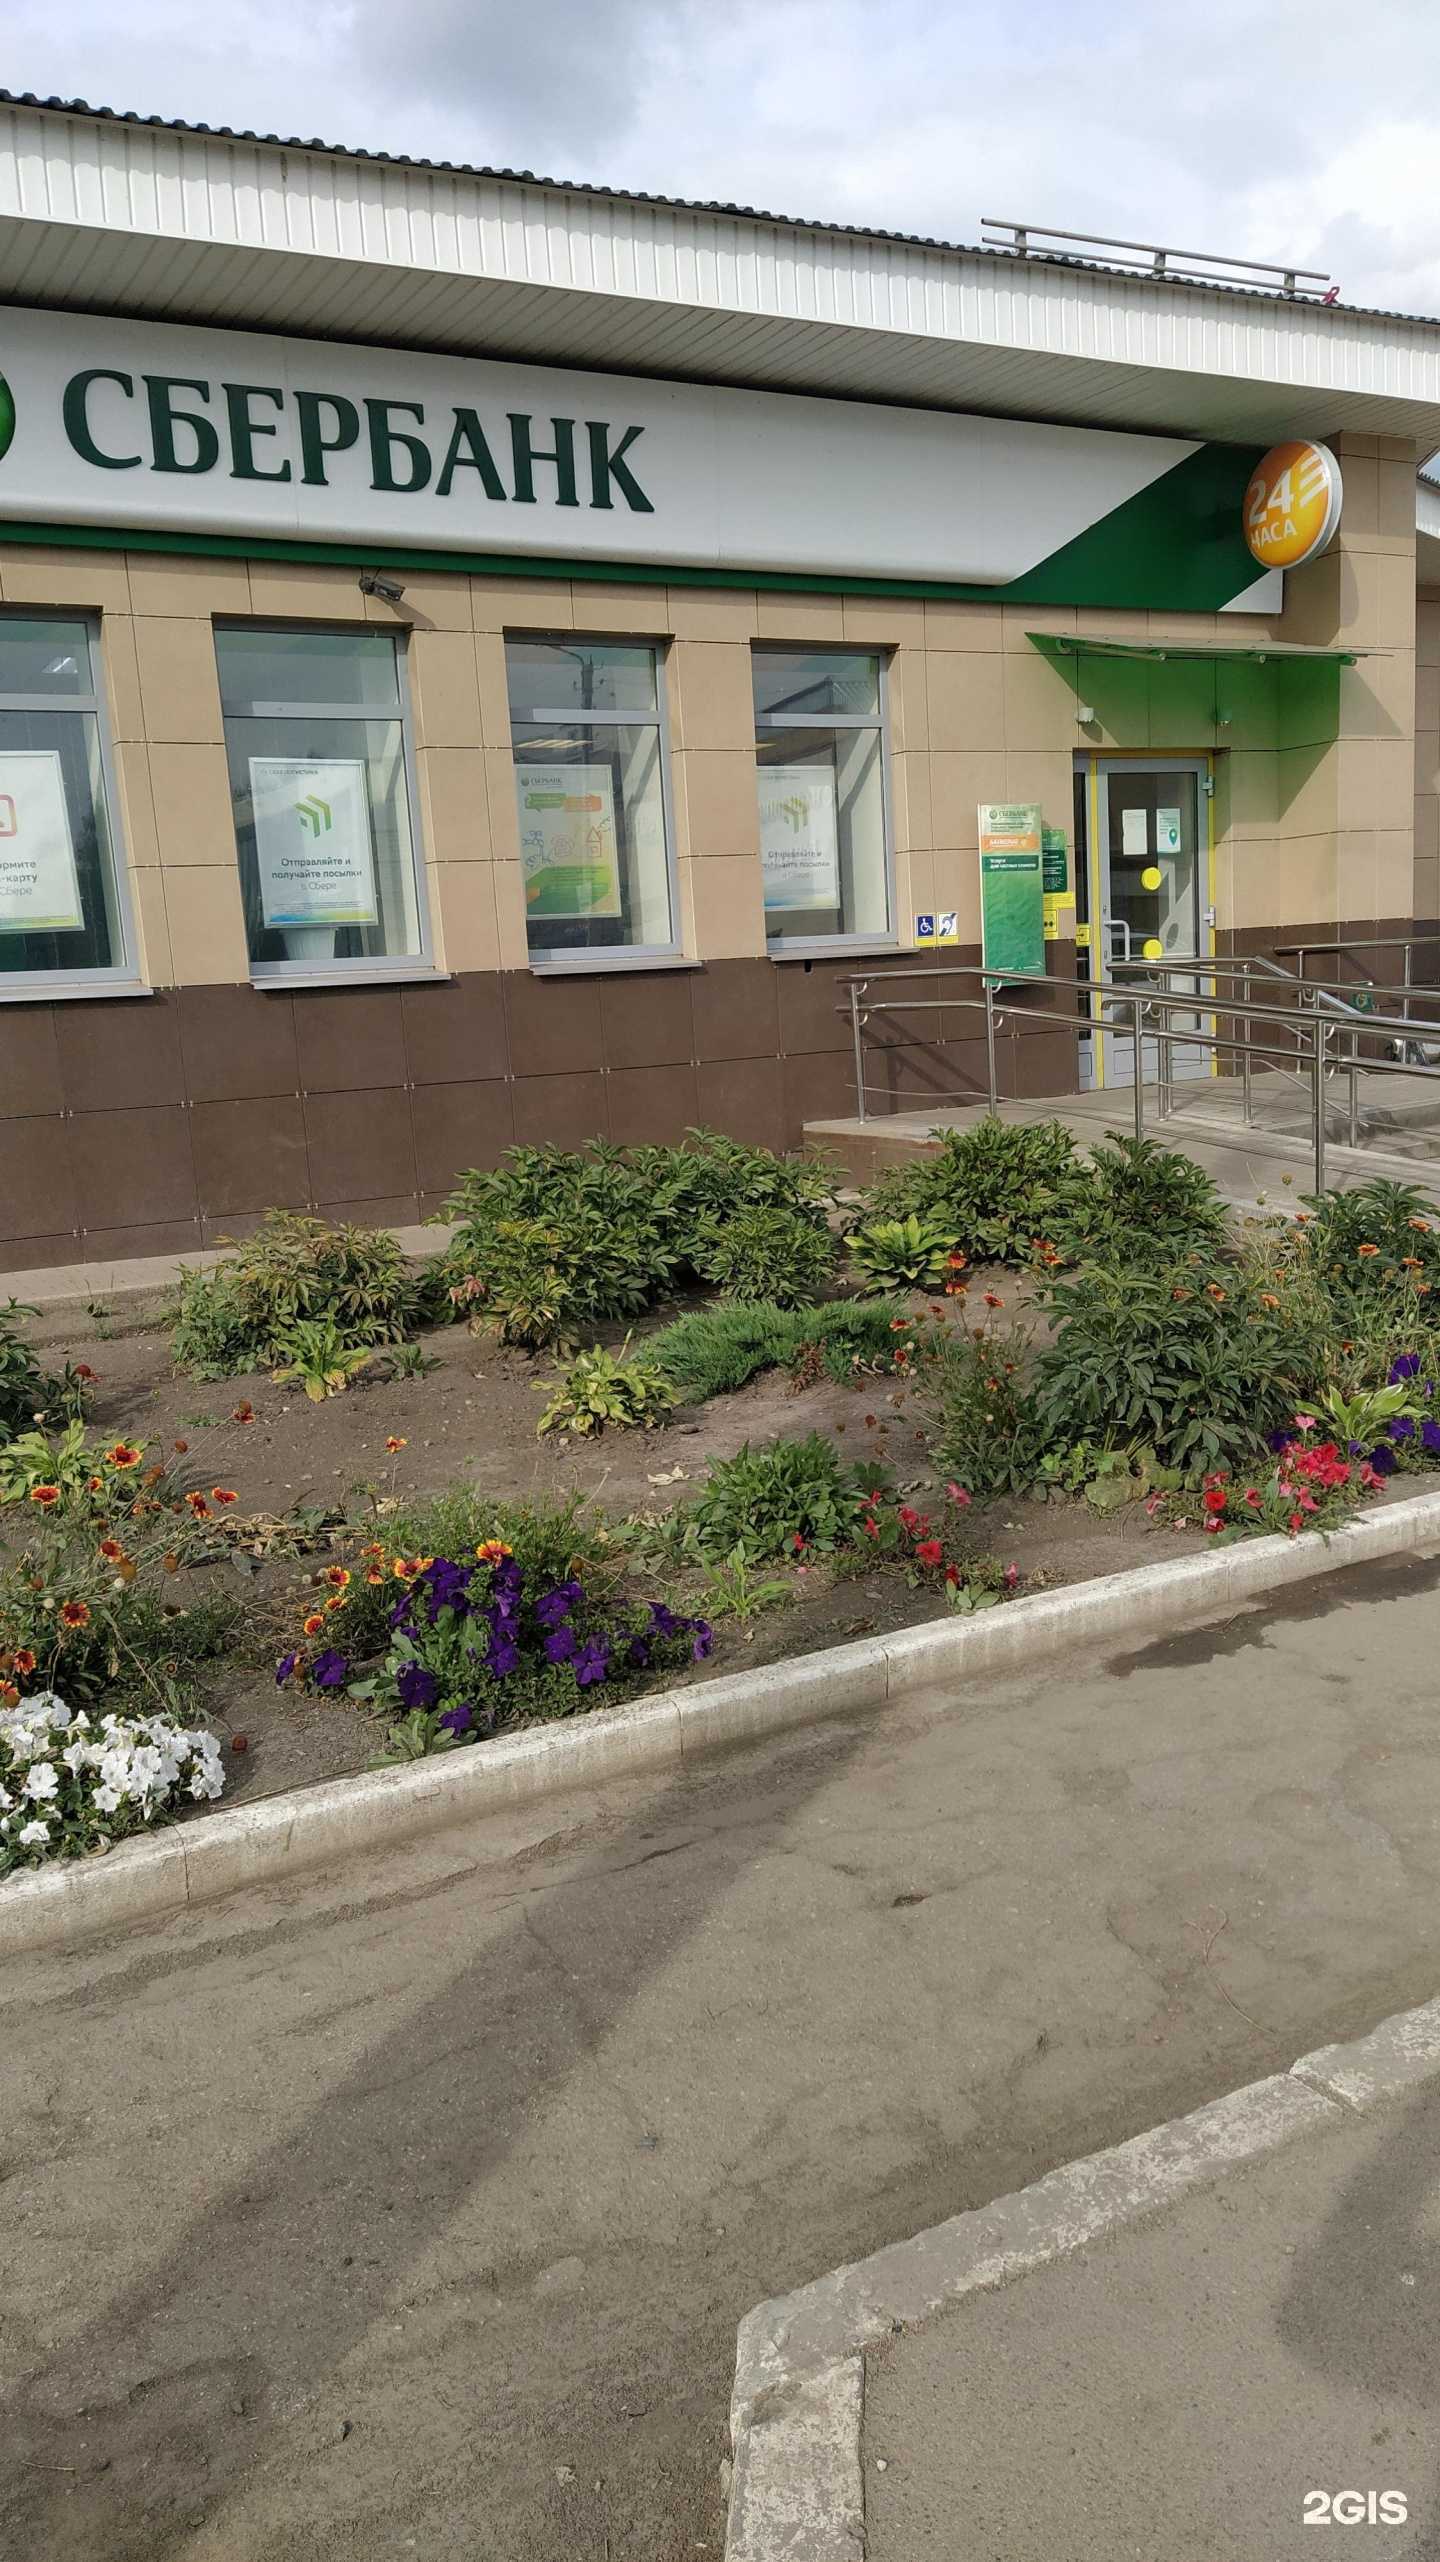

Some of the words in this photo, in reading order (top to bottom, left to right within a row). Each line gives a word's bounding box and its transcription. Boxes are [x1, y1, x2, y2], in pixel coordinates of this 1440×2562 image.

[62, 367, 656, 513] СБЕРБАНК
[1248, 468, 1295, 527] 24
[1250, 518, 1298, 550] ЧАСА
[271, 870, 321, 880] получайте
[323, 869, 362, 878] посылки
[281, 857, 343, 867] Отправляйте
